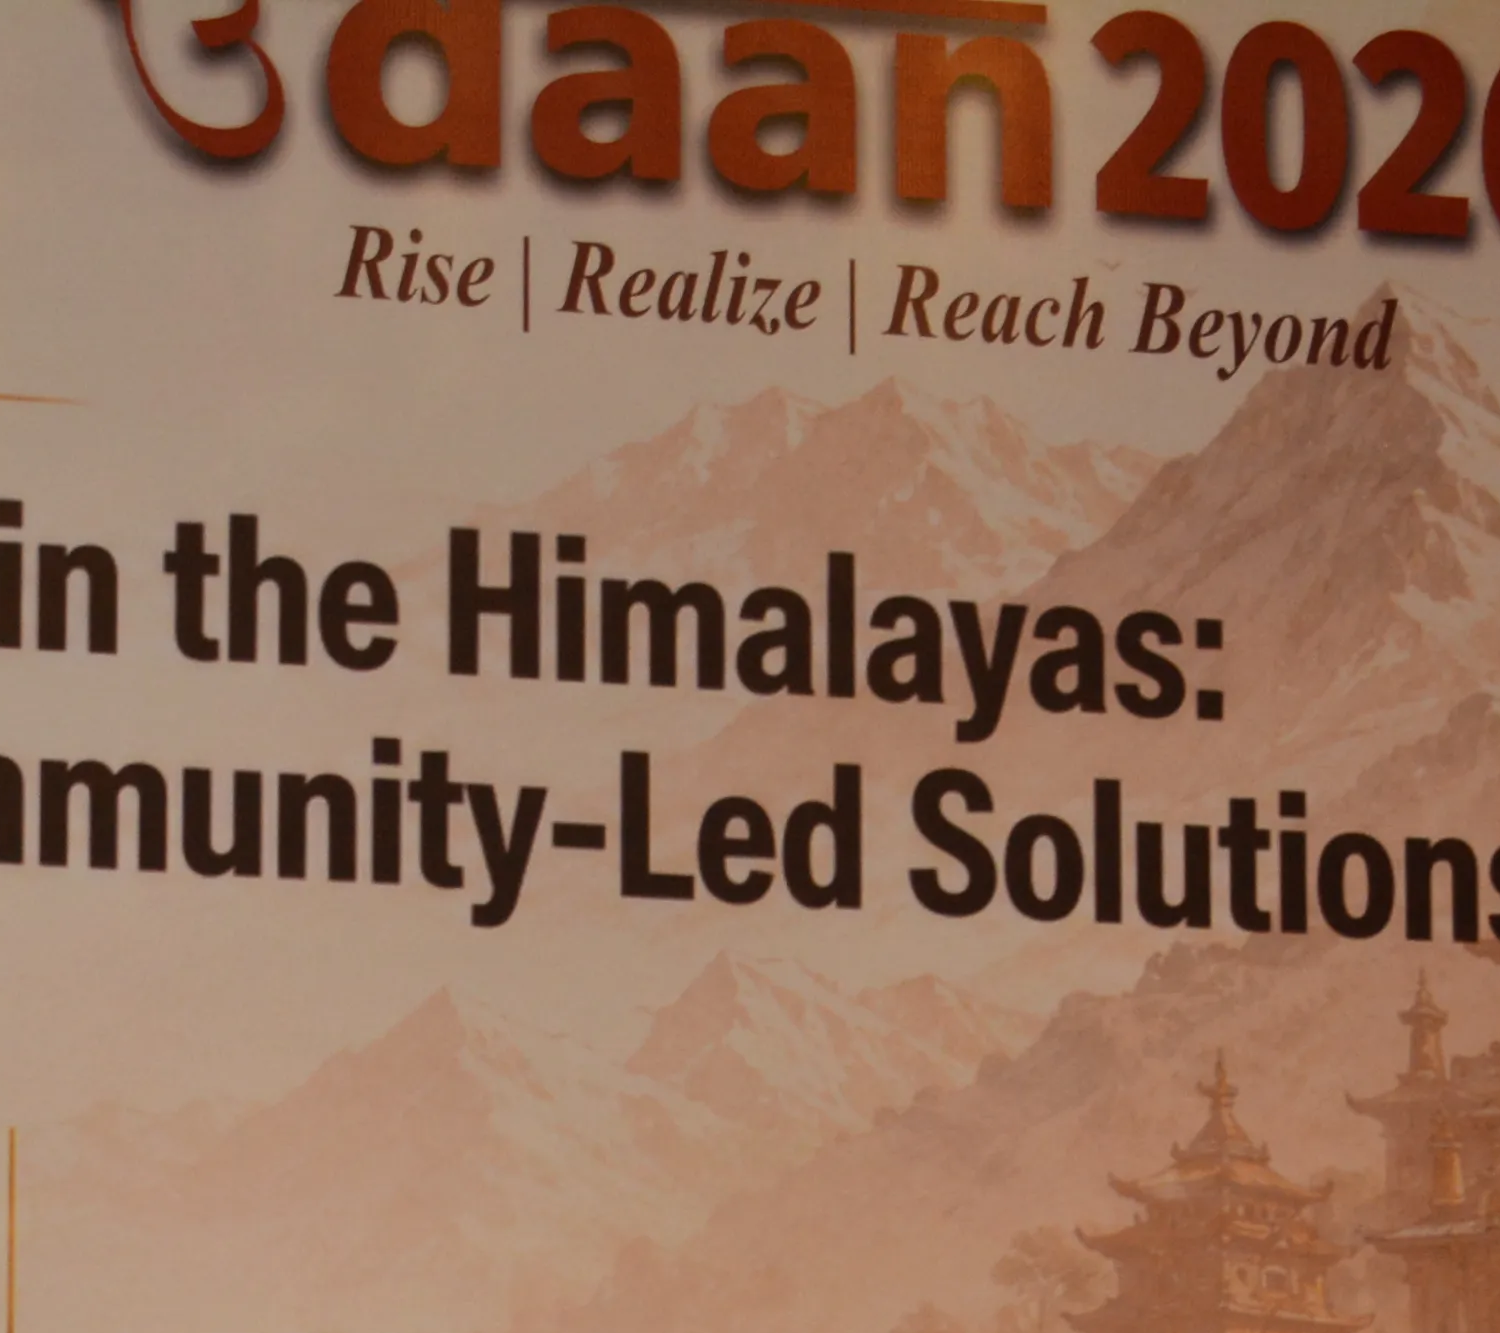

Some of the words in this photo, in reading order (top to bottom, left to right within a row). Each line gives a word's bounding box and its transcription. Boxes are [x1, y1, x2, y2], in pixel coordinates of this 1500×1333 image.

[334, 225, 495, 308] Rise
[557, 240, 822, 336] Realize
[881, 263, 1106, 350] Reach
[1131, 281, 1398, 382] Beyond
[163, 513, 399, 671] the
[446, 527, 1224, 743] Himalayas:
